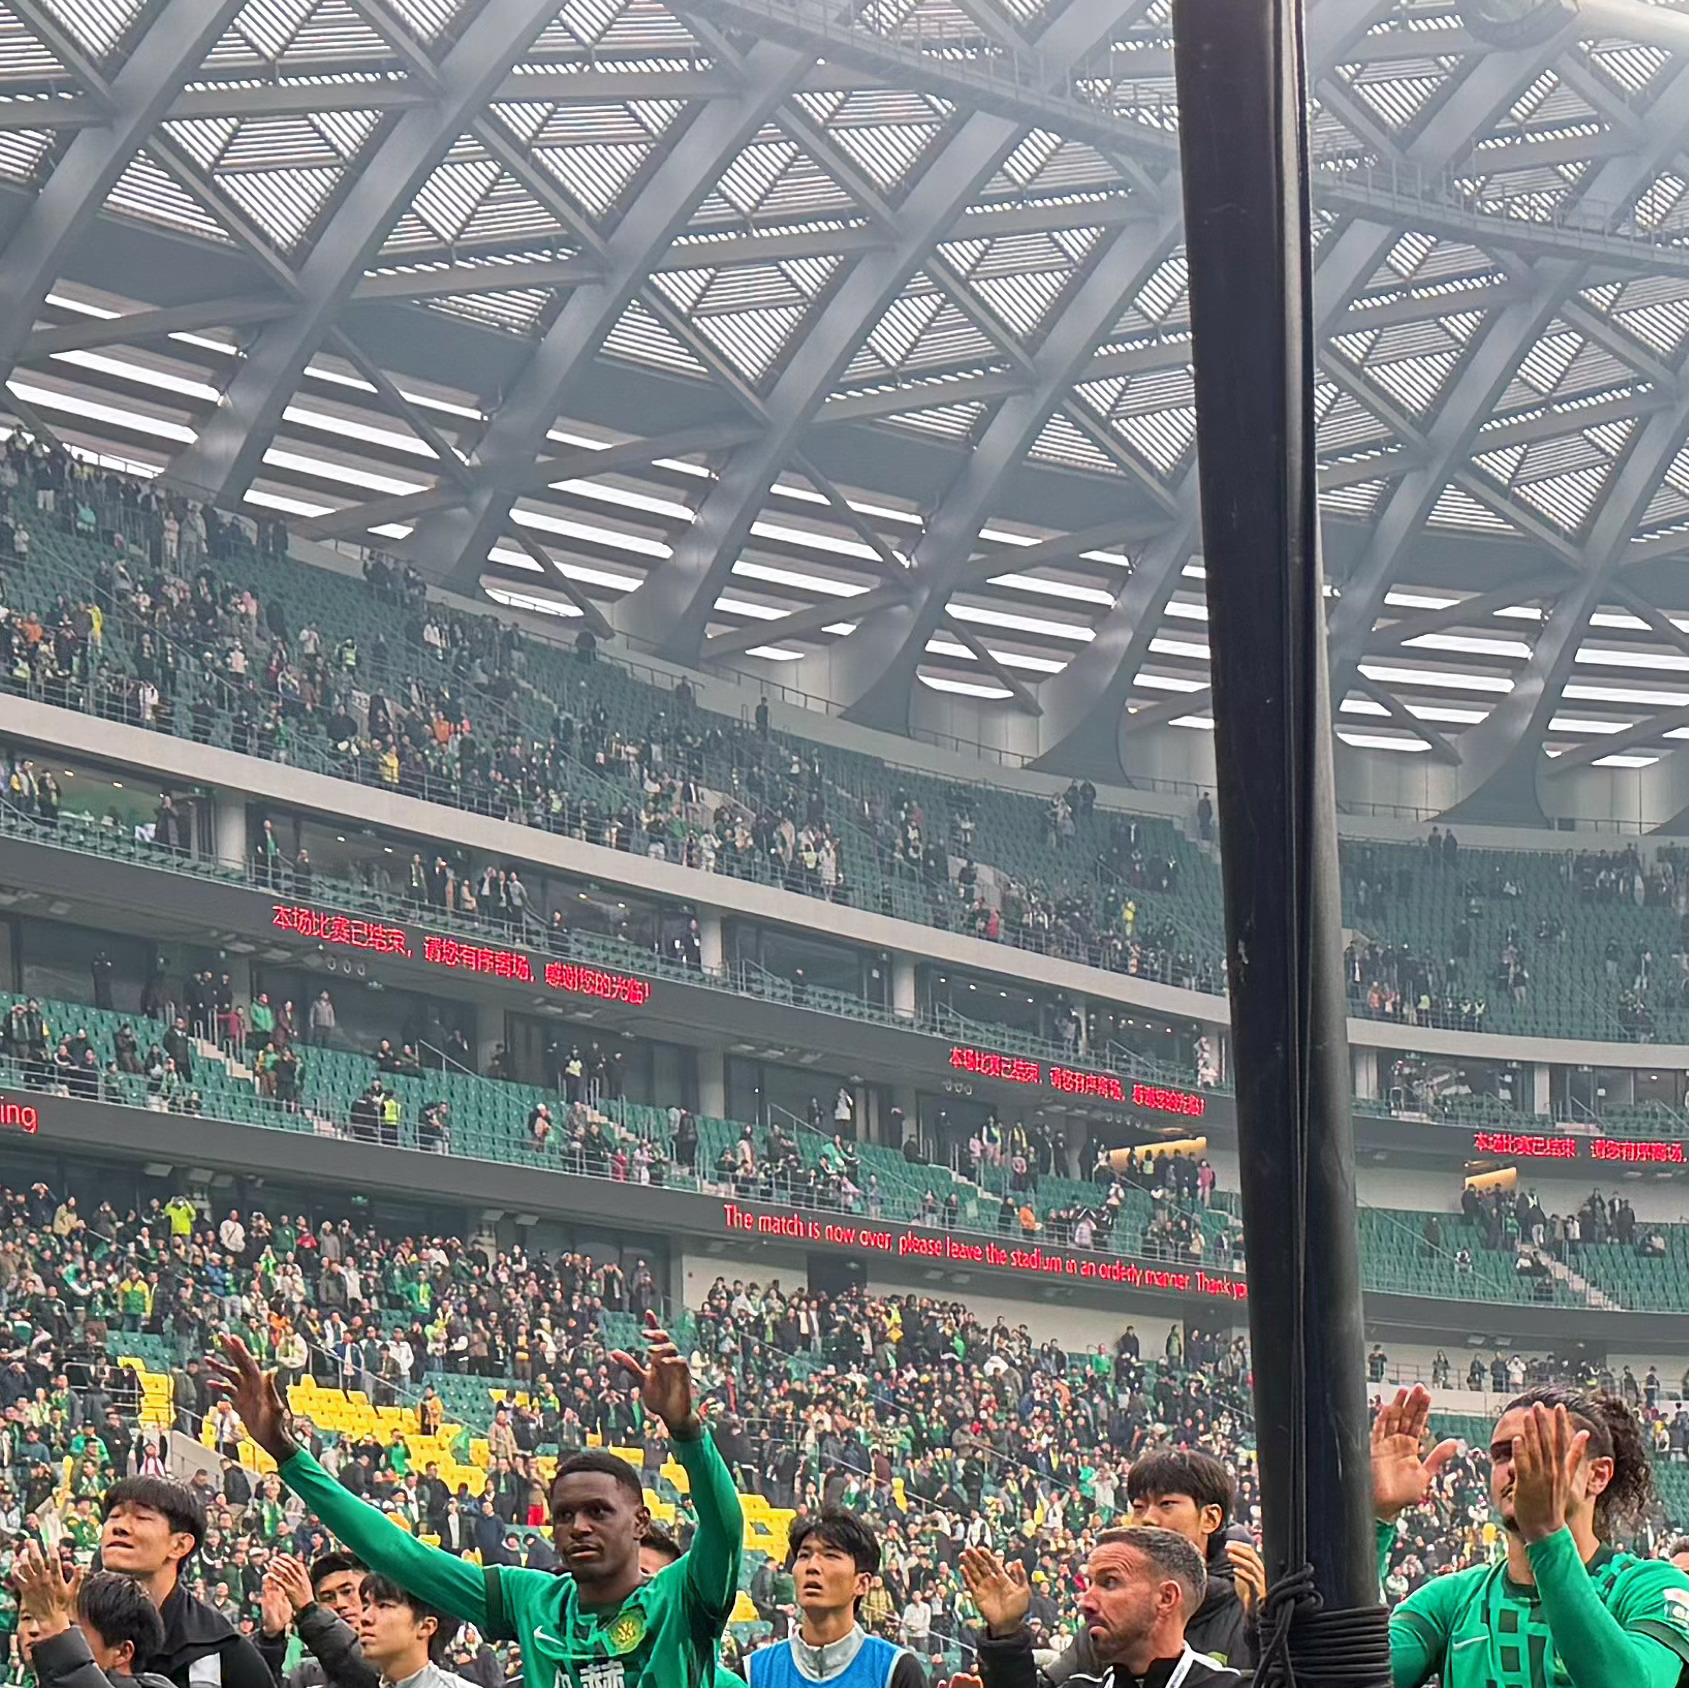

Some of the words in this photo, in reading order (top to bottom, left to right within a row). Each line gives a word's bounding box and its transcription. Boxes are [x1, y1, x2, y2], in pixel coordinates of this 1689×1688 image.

[724, 1204, 755, 1232] The
[758, 1214, 806, 1239] match
[808, 1222, 822, 1240] is
[826, 1226, 857, 1246] now
[898, 1232, 944, 1258] please
[946, 1236, 984, 1262] leave
[985, 1244, 1008, 1266] the
[1009, 1248, 1063, 1274] stadium
[1066, 1258, 1078, 1276] in
[1080, 1262, 1097, 1278] an
[1098, 1260, 1143, 1288] orderly
[1196, 1272, 1231, 1296] Thank
